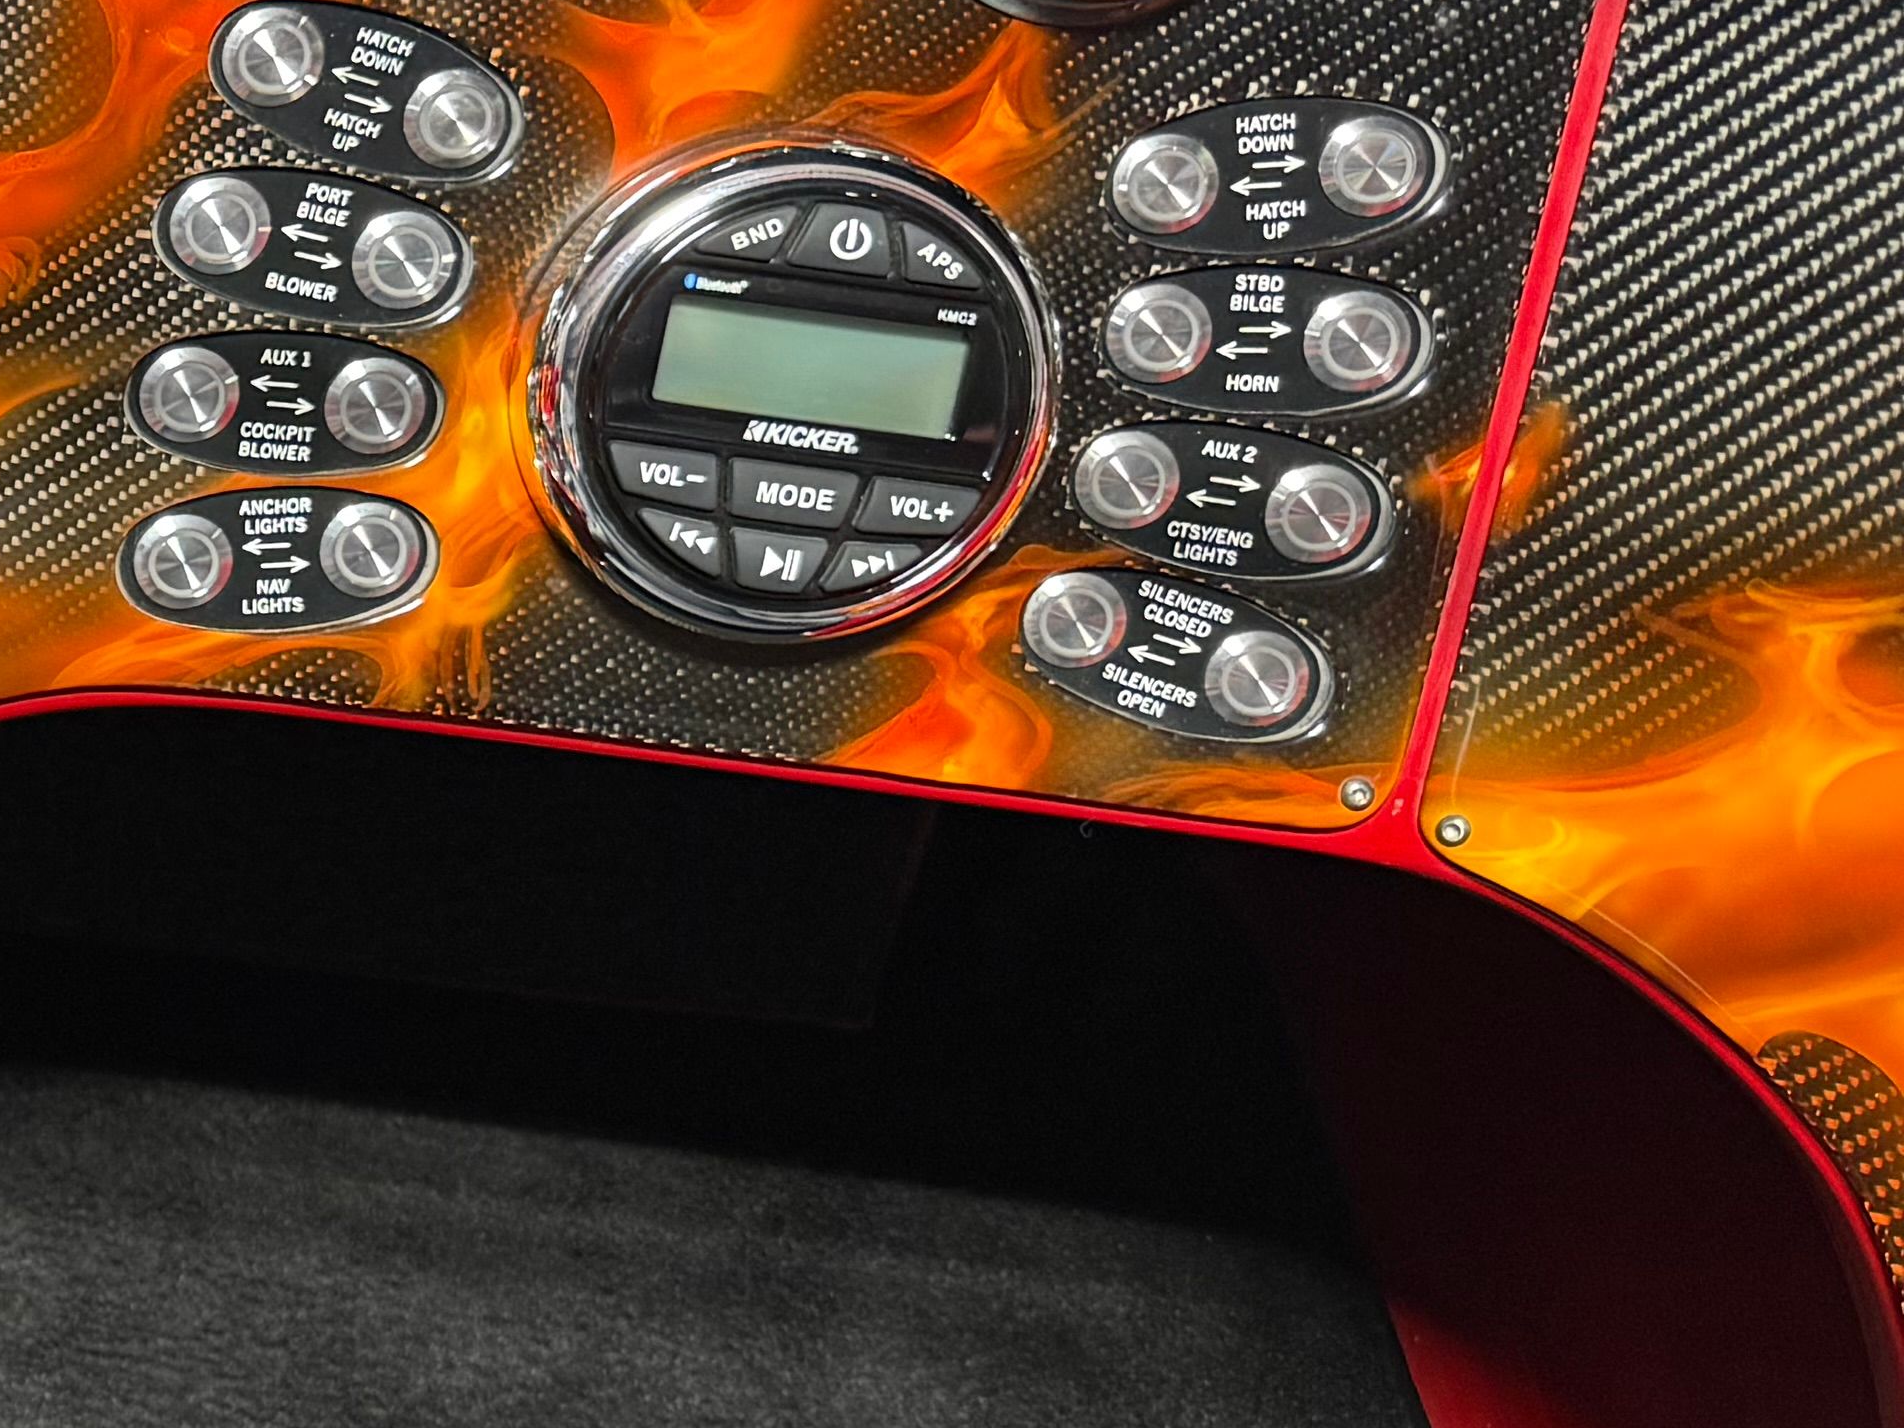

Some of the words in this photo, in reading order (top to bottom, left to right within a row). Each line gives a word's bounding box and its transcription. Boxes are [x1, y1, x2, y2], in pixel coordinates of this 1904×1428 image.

[356, 26, 416, 57] HATCH
[350, 45, 405, 76] DOWN
[323, 108, 384, 140] HATCH
[1235, 112, 1297, 135] HATCH
[332, 130, 361, 153] UP
[1238, 134, 1295, 155] DOWN
[305, 182, 355, 207] PORT
[296, 204, 351, 228] BILGE
[1245, 199, 1306, 222] HATCH
[730, 216, 785, 254] BND
[1262, 222, 1291, 240] UP
[916, 241, 965, 281] APS
[265, 272, 339, 303] BLOWER
[1234, 274, 1285, 293] STBD
[1229, 293, 1285, 314] BILGE
[937, 308, 978, 326] KMC2
[260, 348, 298, 367] AUX
[301, 350, 312, 367] 1
[1225, 374, 1280, 394] HORN
[239, 420, 317, 444] COCKPIT
[238, 441, 312, 463] BLOWER
[1201, 439, 1243, 461] AUX
[1244, 445, 1258, 464] 2
[238, 497, 313, 518] ANCHOR
[755, 482, 837, 512] MODE
[244, 516, 309, 536] LIGHTS
[1166, 520, 1254, 549] CTSY/ENG
[1173, 543, 1239, 567] LIGHTS
[255, 578, 291, 596] NAV
[241, 595, 305, 616] LIGHTS
[1138, 579, 1235, 626] SILENCERS
[1143, 602, 1212, 639] CLOSED
[1101, 662, 1198, 709] SILENCERS
[1117, 690, 1166, 719] OPEN
